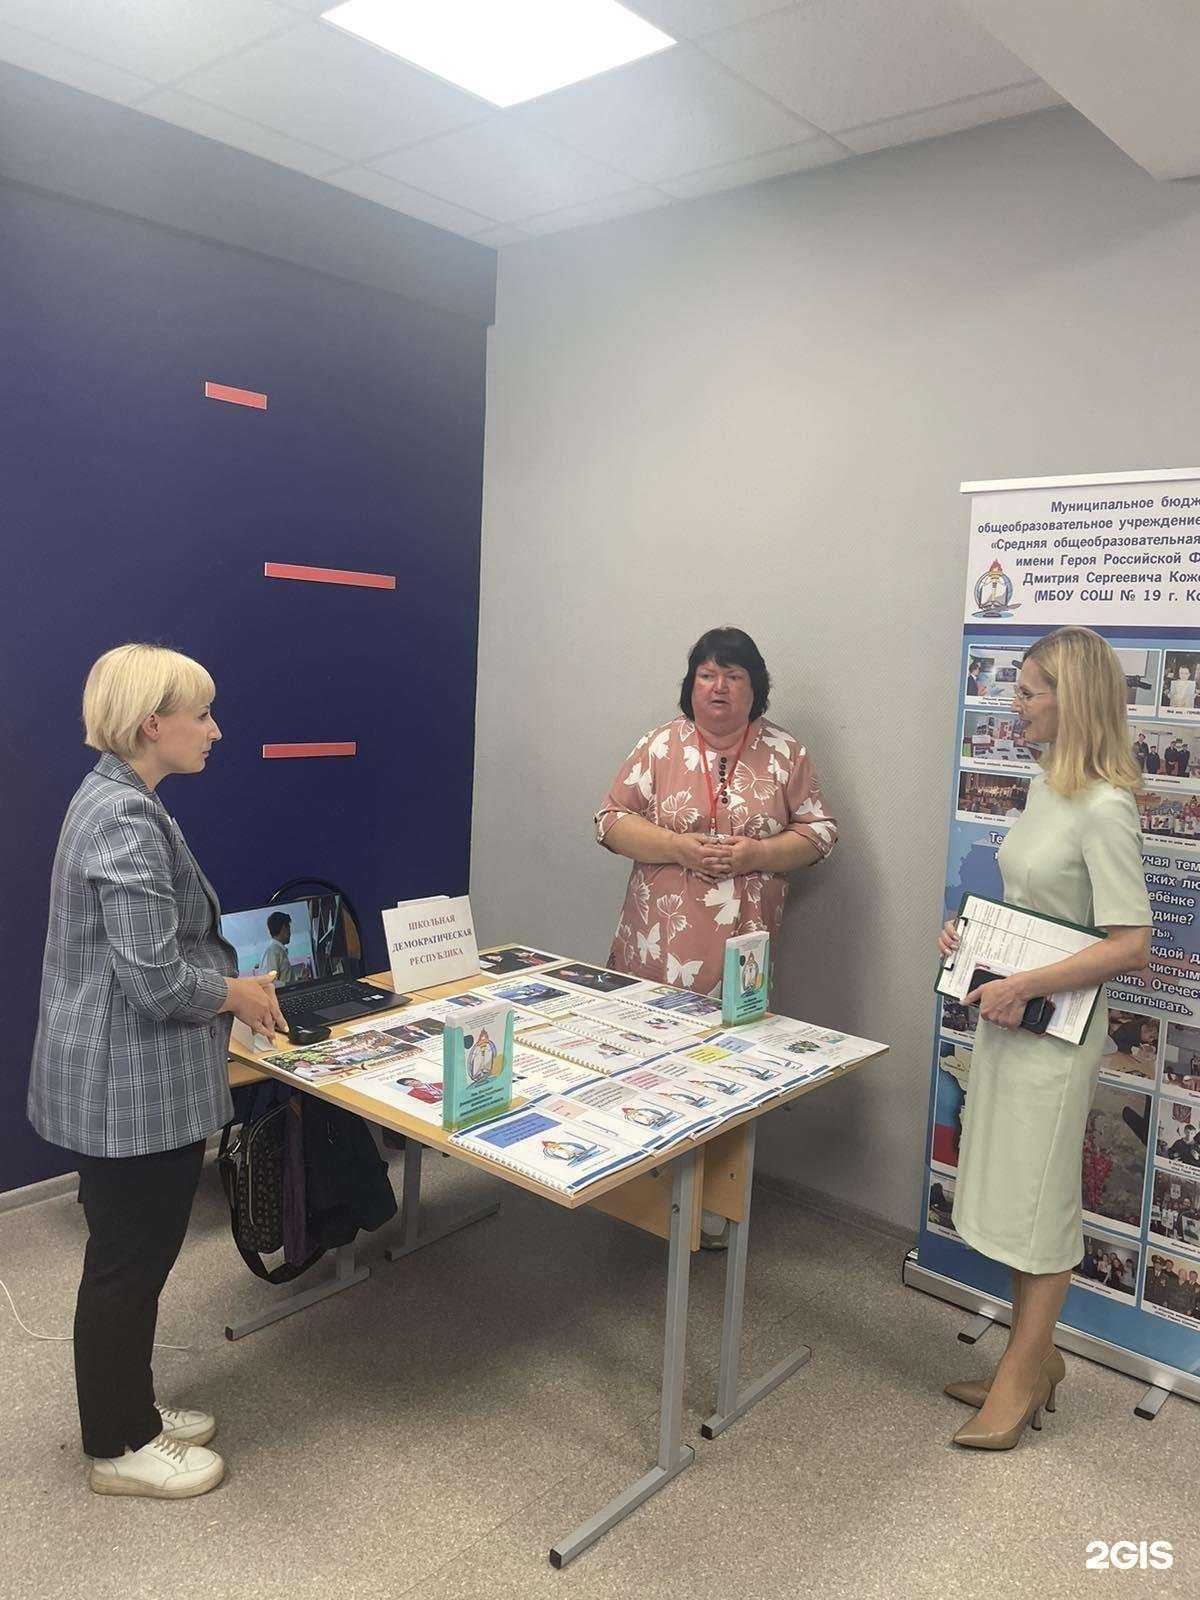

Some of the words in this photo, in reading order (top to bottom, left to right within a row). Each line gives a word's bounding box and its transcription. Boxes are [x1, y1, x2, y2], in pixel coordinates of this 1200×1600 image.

[1051, 499, 1154, 514] Муниципальное
[978, 519, 1113, 533] общеобразовательное
[991, 538, 1047, 551] «Средняя
[1053, 535, 1200, 549] общеобразовательная
[1016, 557, 1054, 567] имени
[1060, 554, 1096, 567] Героя
[1104, 552, 1181, 565] Российской
[1023, 572, 1079, 586] Дмитрия
[1086, 571, 1162, 585] Сергеевича
[1034, 589, 1074, 603] (МБОУ
[1080, 589, 1113, 601] СОШ
[1120, 589, 1136, 601] №
[1144, 589, 1161, 601] 19
[1168, 592, 1178, 601] г.
[990, 832, 1007, 844] Те
[408, 914, 456, 930] ШКОЛЬНАЯ
[392, 928, 473, 953] ДЕМОКРАТИЧЕСКАЯ
[409, 947, 464, 967] РЕСПУБЛИКА
[1152, 979, 1200, 998] Отечес
